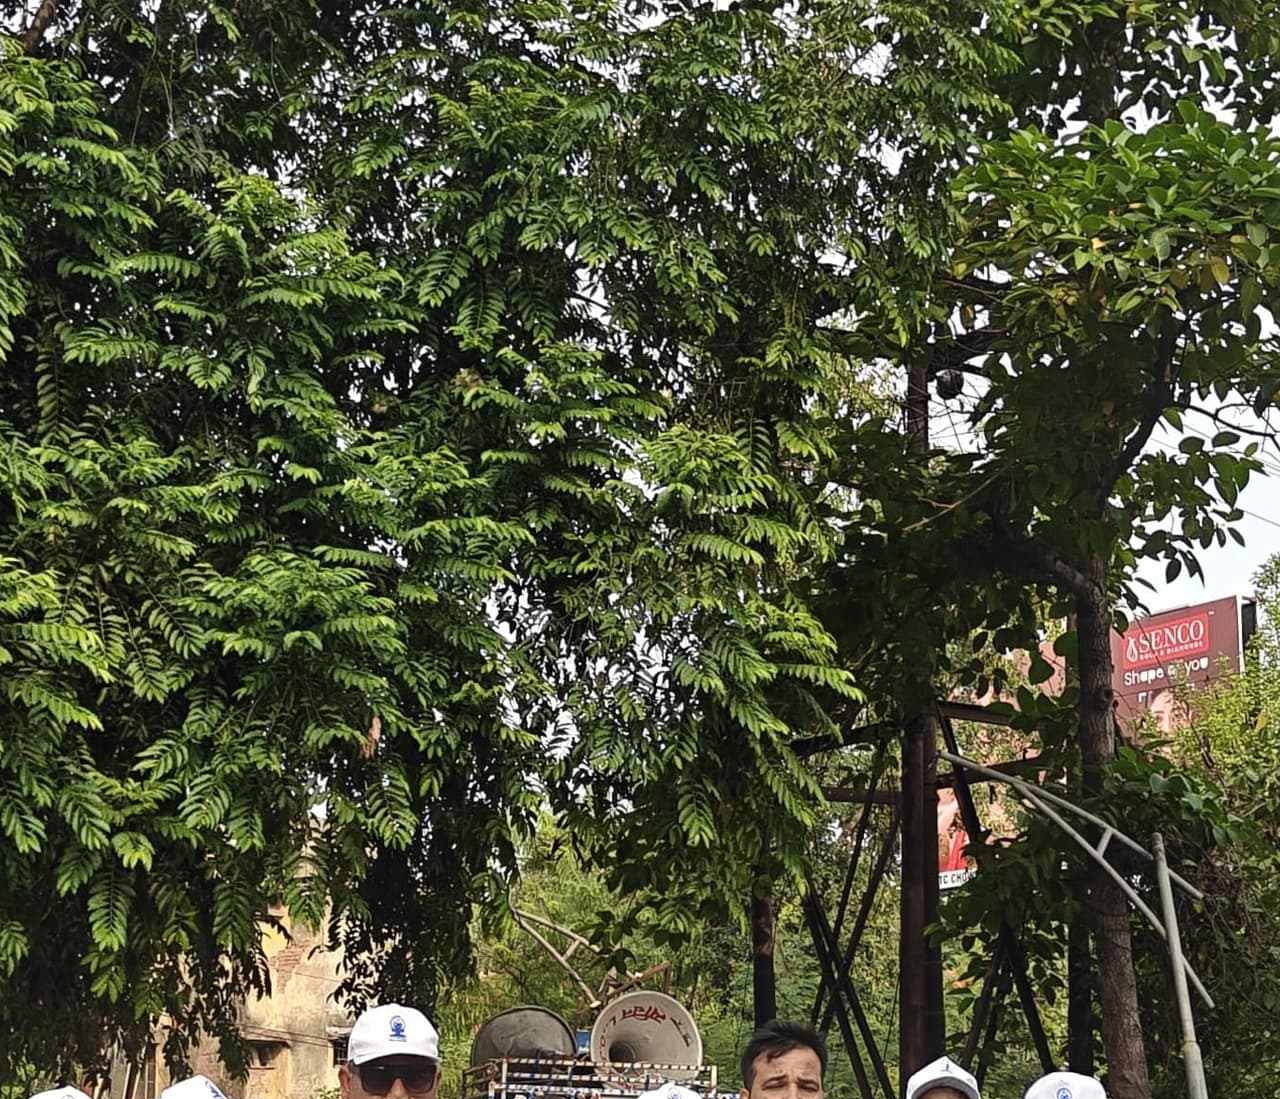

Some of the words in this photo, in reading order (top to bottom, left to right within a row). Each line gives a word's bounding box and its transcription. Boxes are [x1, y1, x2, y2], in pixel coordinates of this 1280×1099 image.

[1139, 620, 1204, 652] SENCO
[1124, 667, 1164, 685] Shape
[1184, 657, 1209, 675] you
